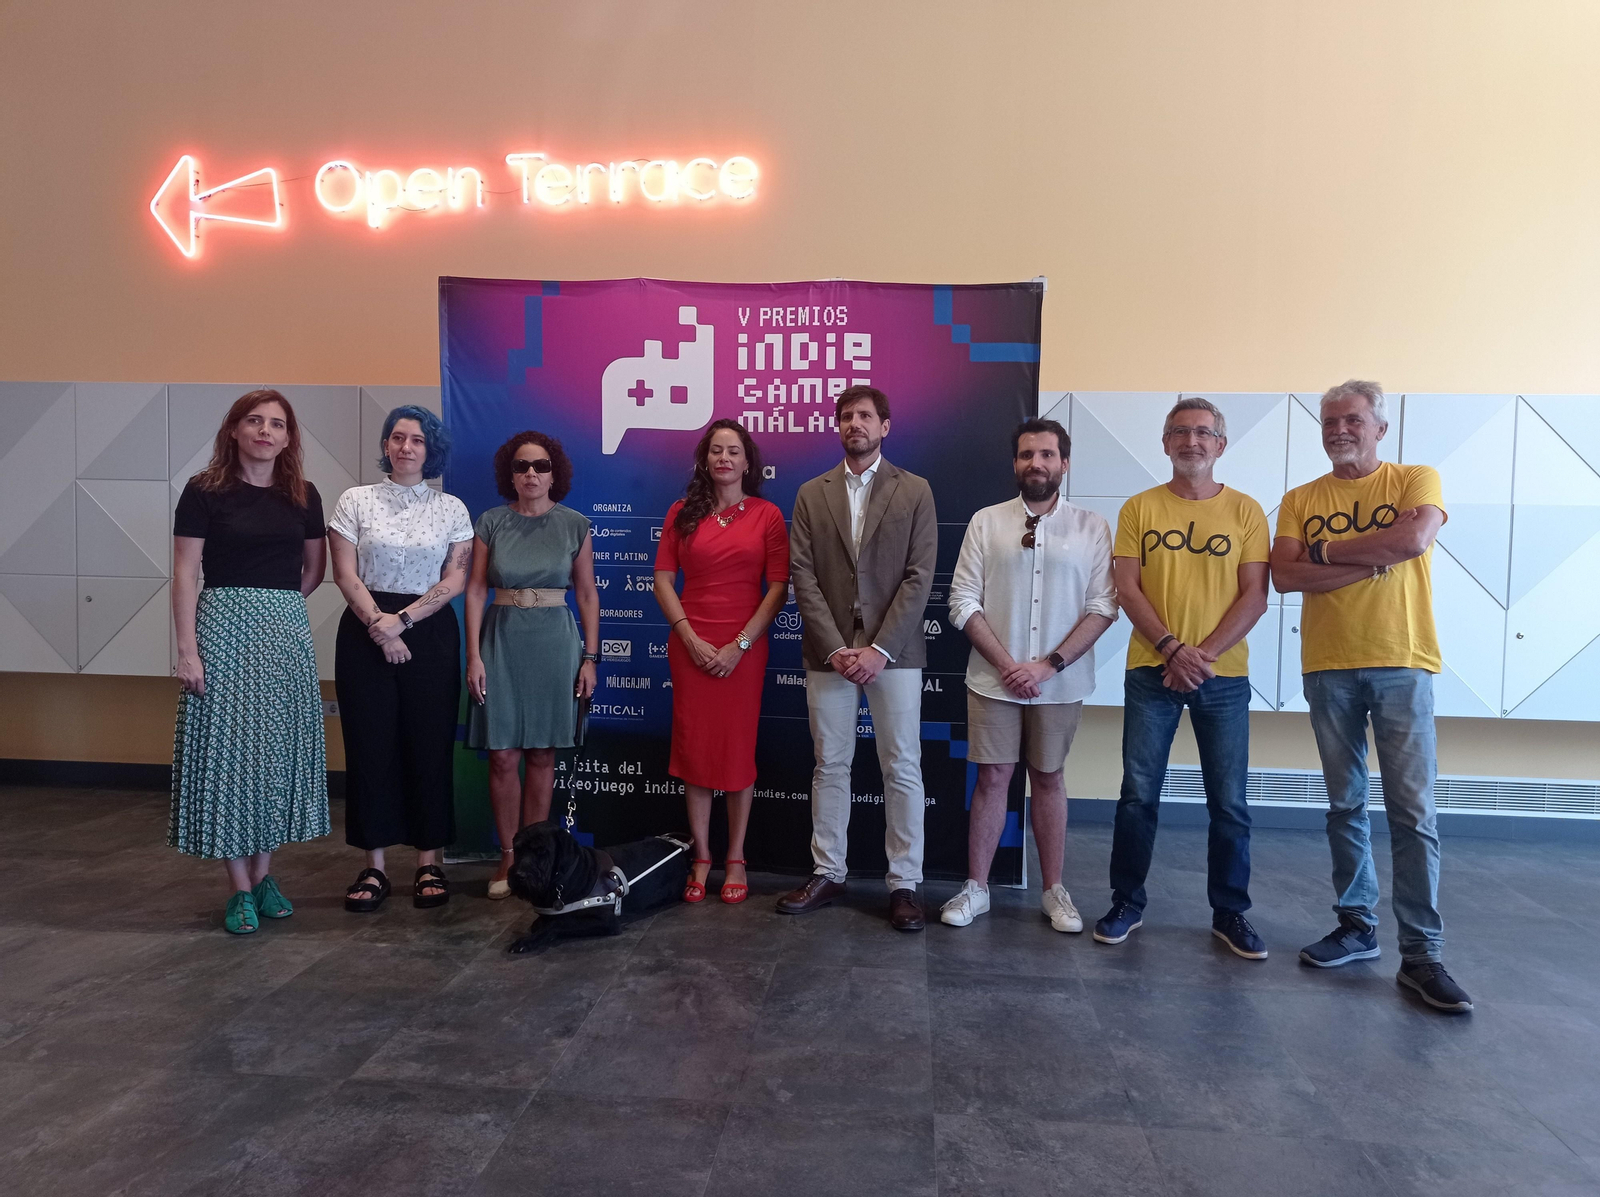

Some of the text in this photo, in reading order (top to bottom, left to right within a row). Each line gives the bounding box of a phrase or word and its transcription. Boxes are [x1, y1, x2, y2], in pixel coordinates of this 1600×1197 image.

[313, 153, 759, 228] Open Terrace
[738, 306, 848, 326] V PREMIOS
[593, 504, 632, 512] ORGANIZA
[592, 552, 648, 561] TNER PLATINO
[636, 582, 654, 591] ON
[600, 609, 643, 618] BORADORES
[773, 632, 803, 640] odders
[606, 674, 651, 689] MÁLAGAJAM
[922, 678, 943, 692] AL
[578, 759, 609, 773] cita
[618, 762, 643, 775] del
[644, 780, 686, 795] indie
